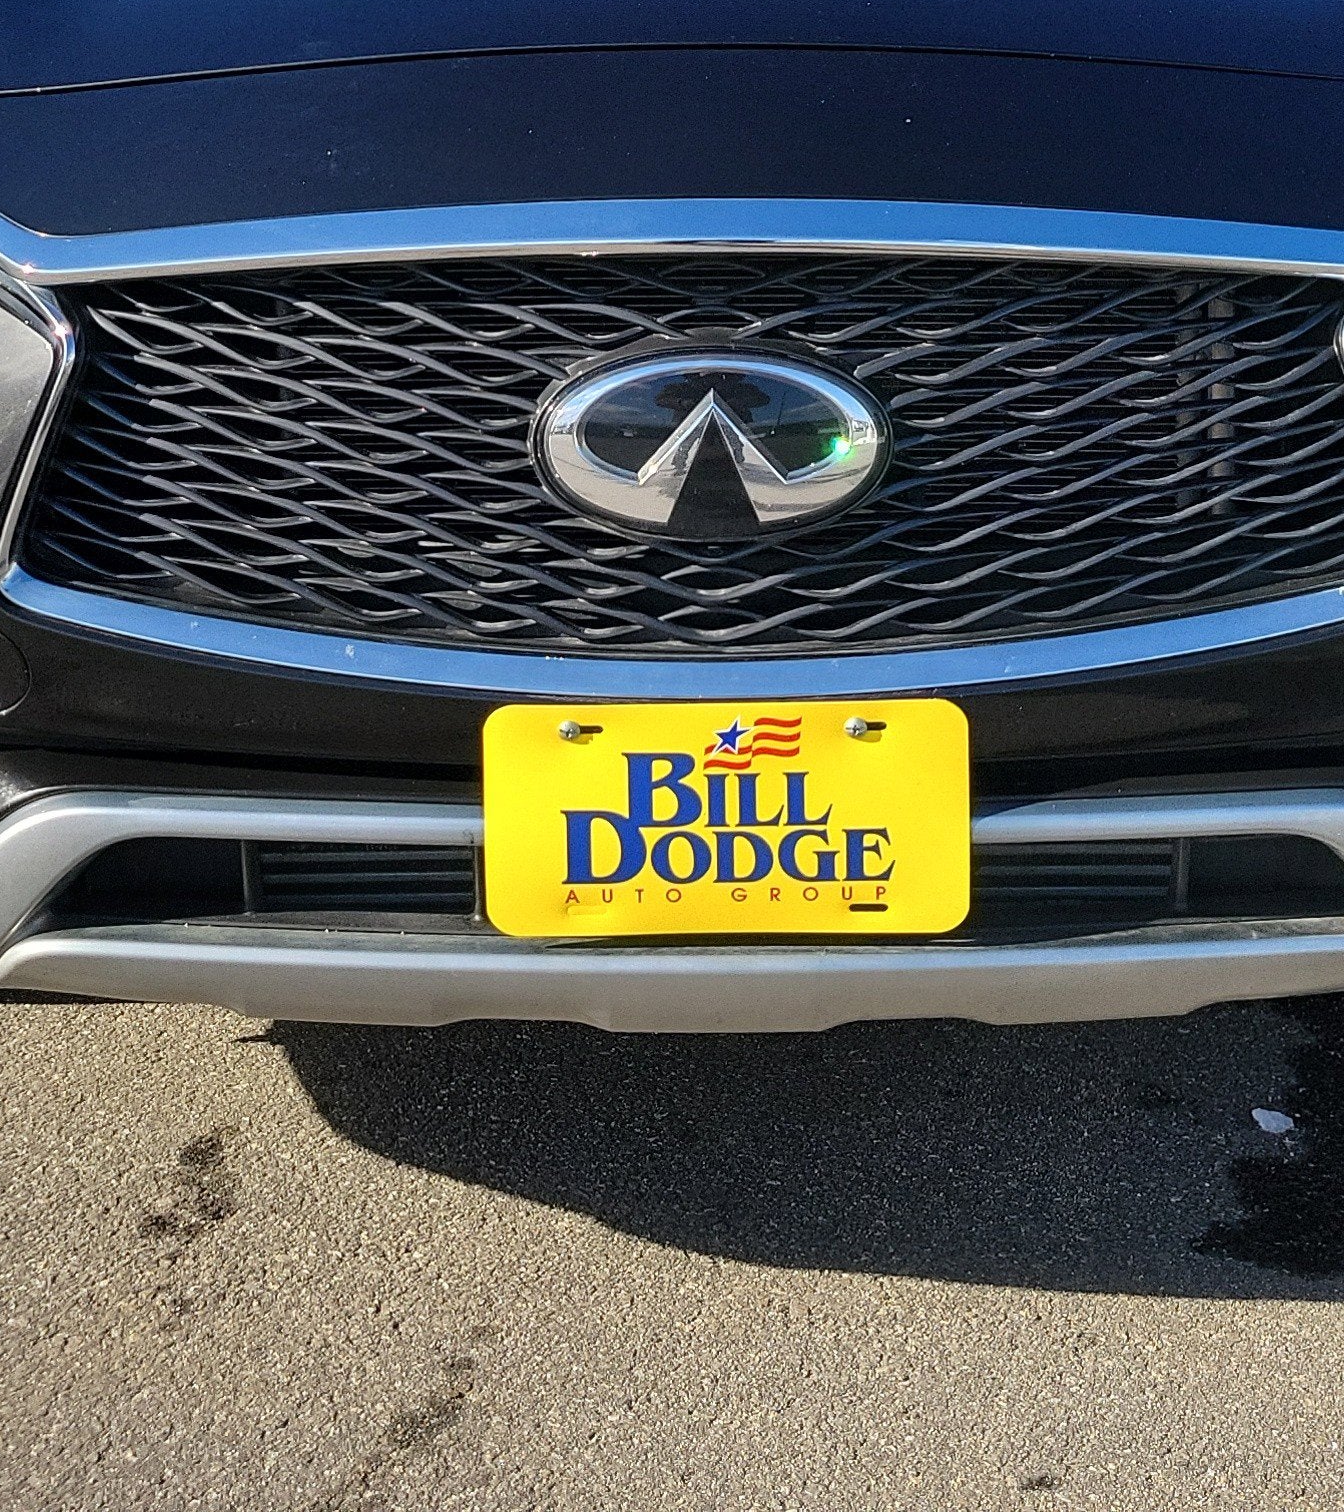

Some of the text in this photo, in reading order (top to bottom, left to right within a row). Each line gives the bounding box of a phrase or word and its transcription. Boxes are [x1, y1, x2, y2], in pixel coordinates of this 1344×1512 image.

[621, 752, 833, 828] BILL
[560, 809, 896, 885] DODGE
[565, 886, 887, 904] AUTO GROUP
